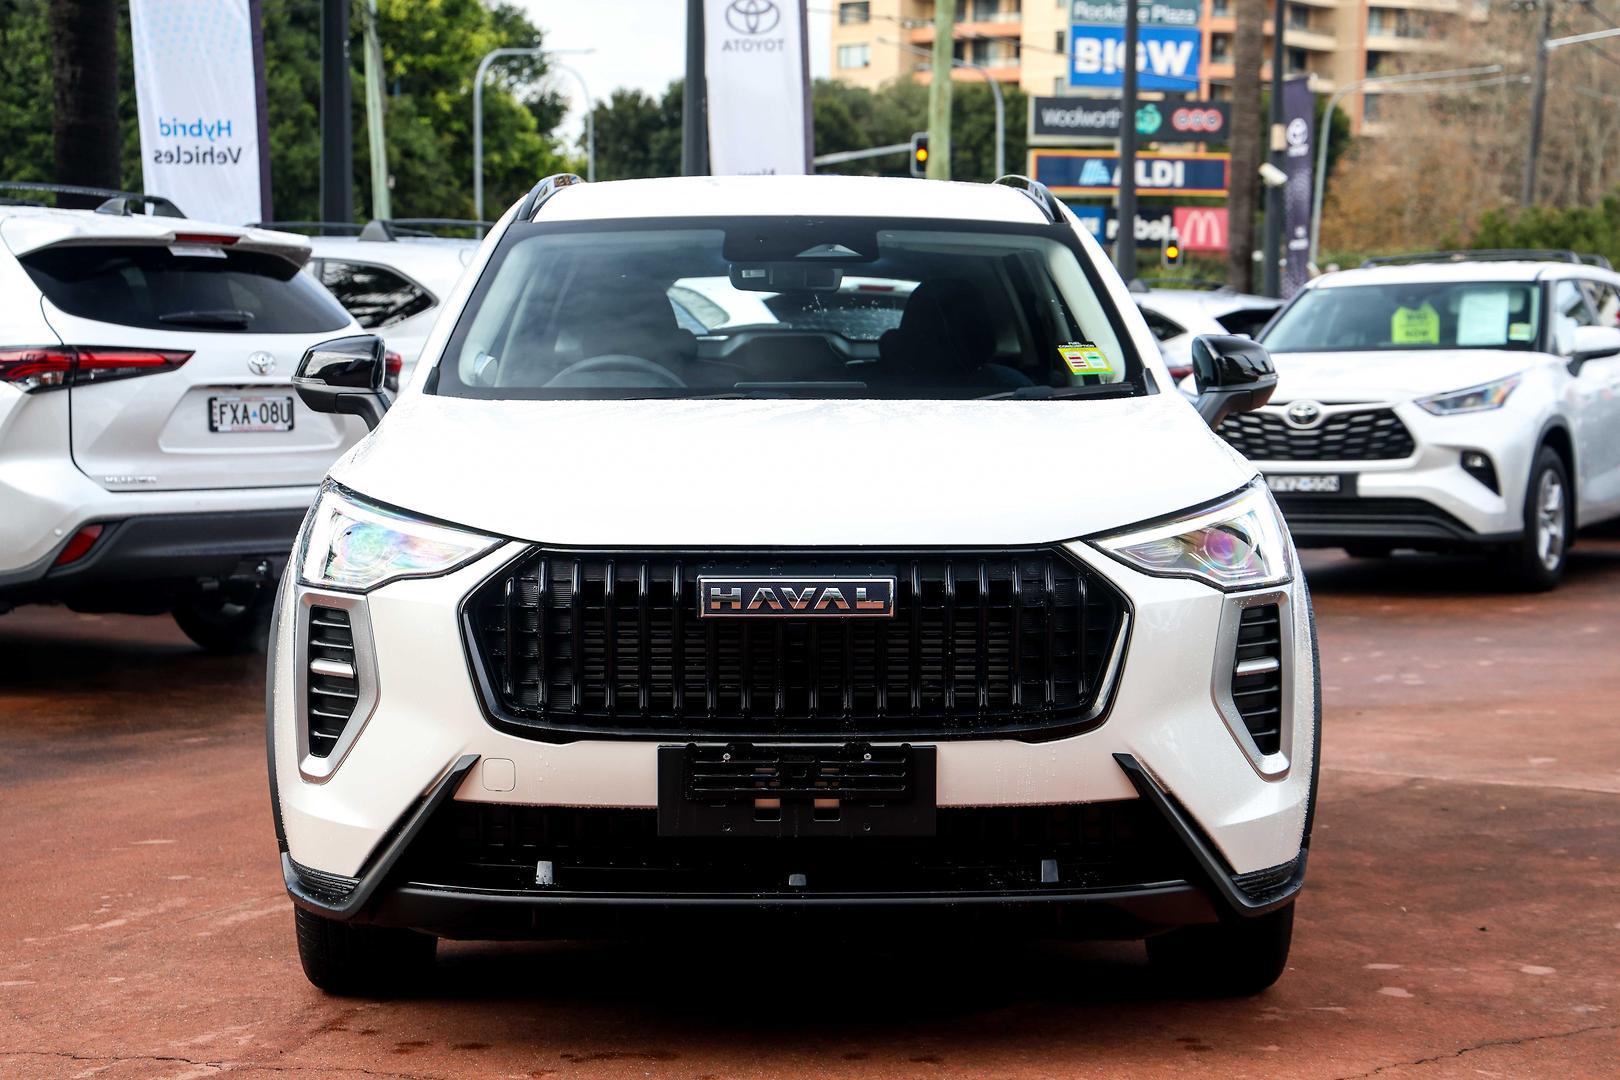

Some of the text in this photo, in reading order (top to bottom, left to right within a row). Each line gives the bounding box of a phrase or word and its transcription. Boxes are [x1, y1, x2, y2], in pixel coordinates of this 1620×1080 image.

[1106, 214, 1171, 240] rbel
[219, 403, 250, 424] FXA
[710, 587, 885, 610] HAVAL
